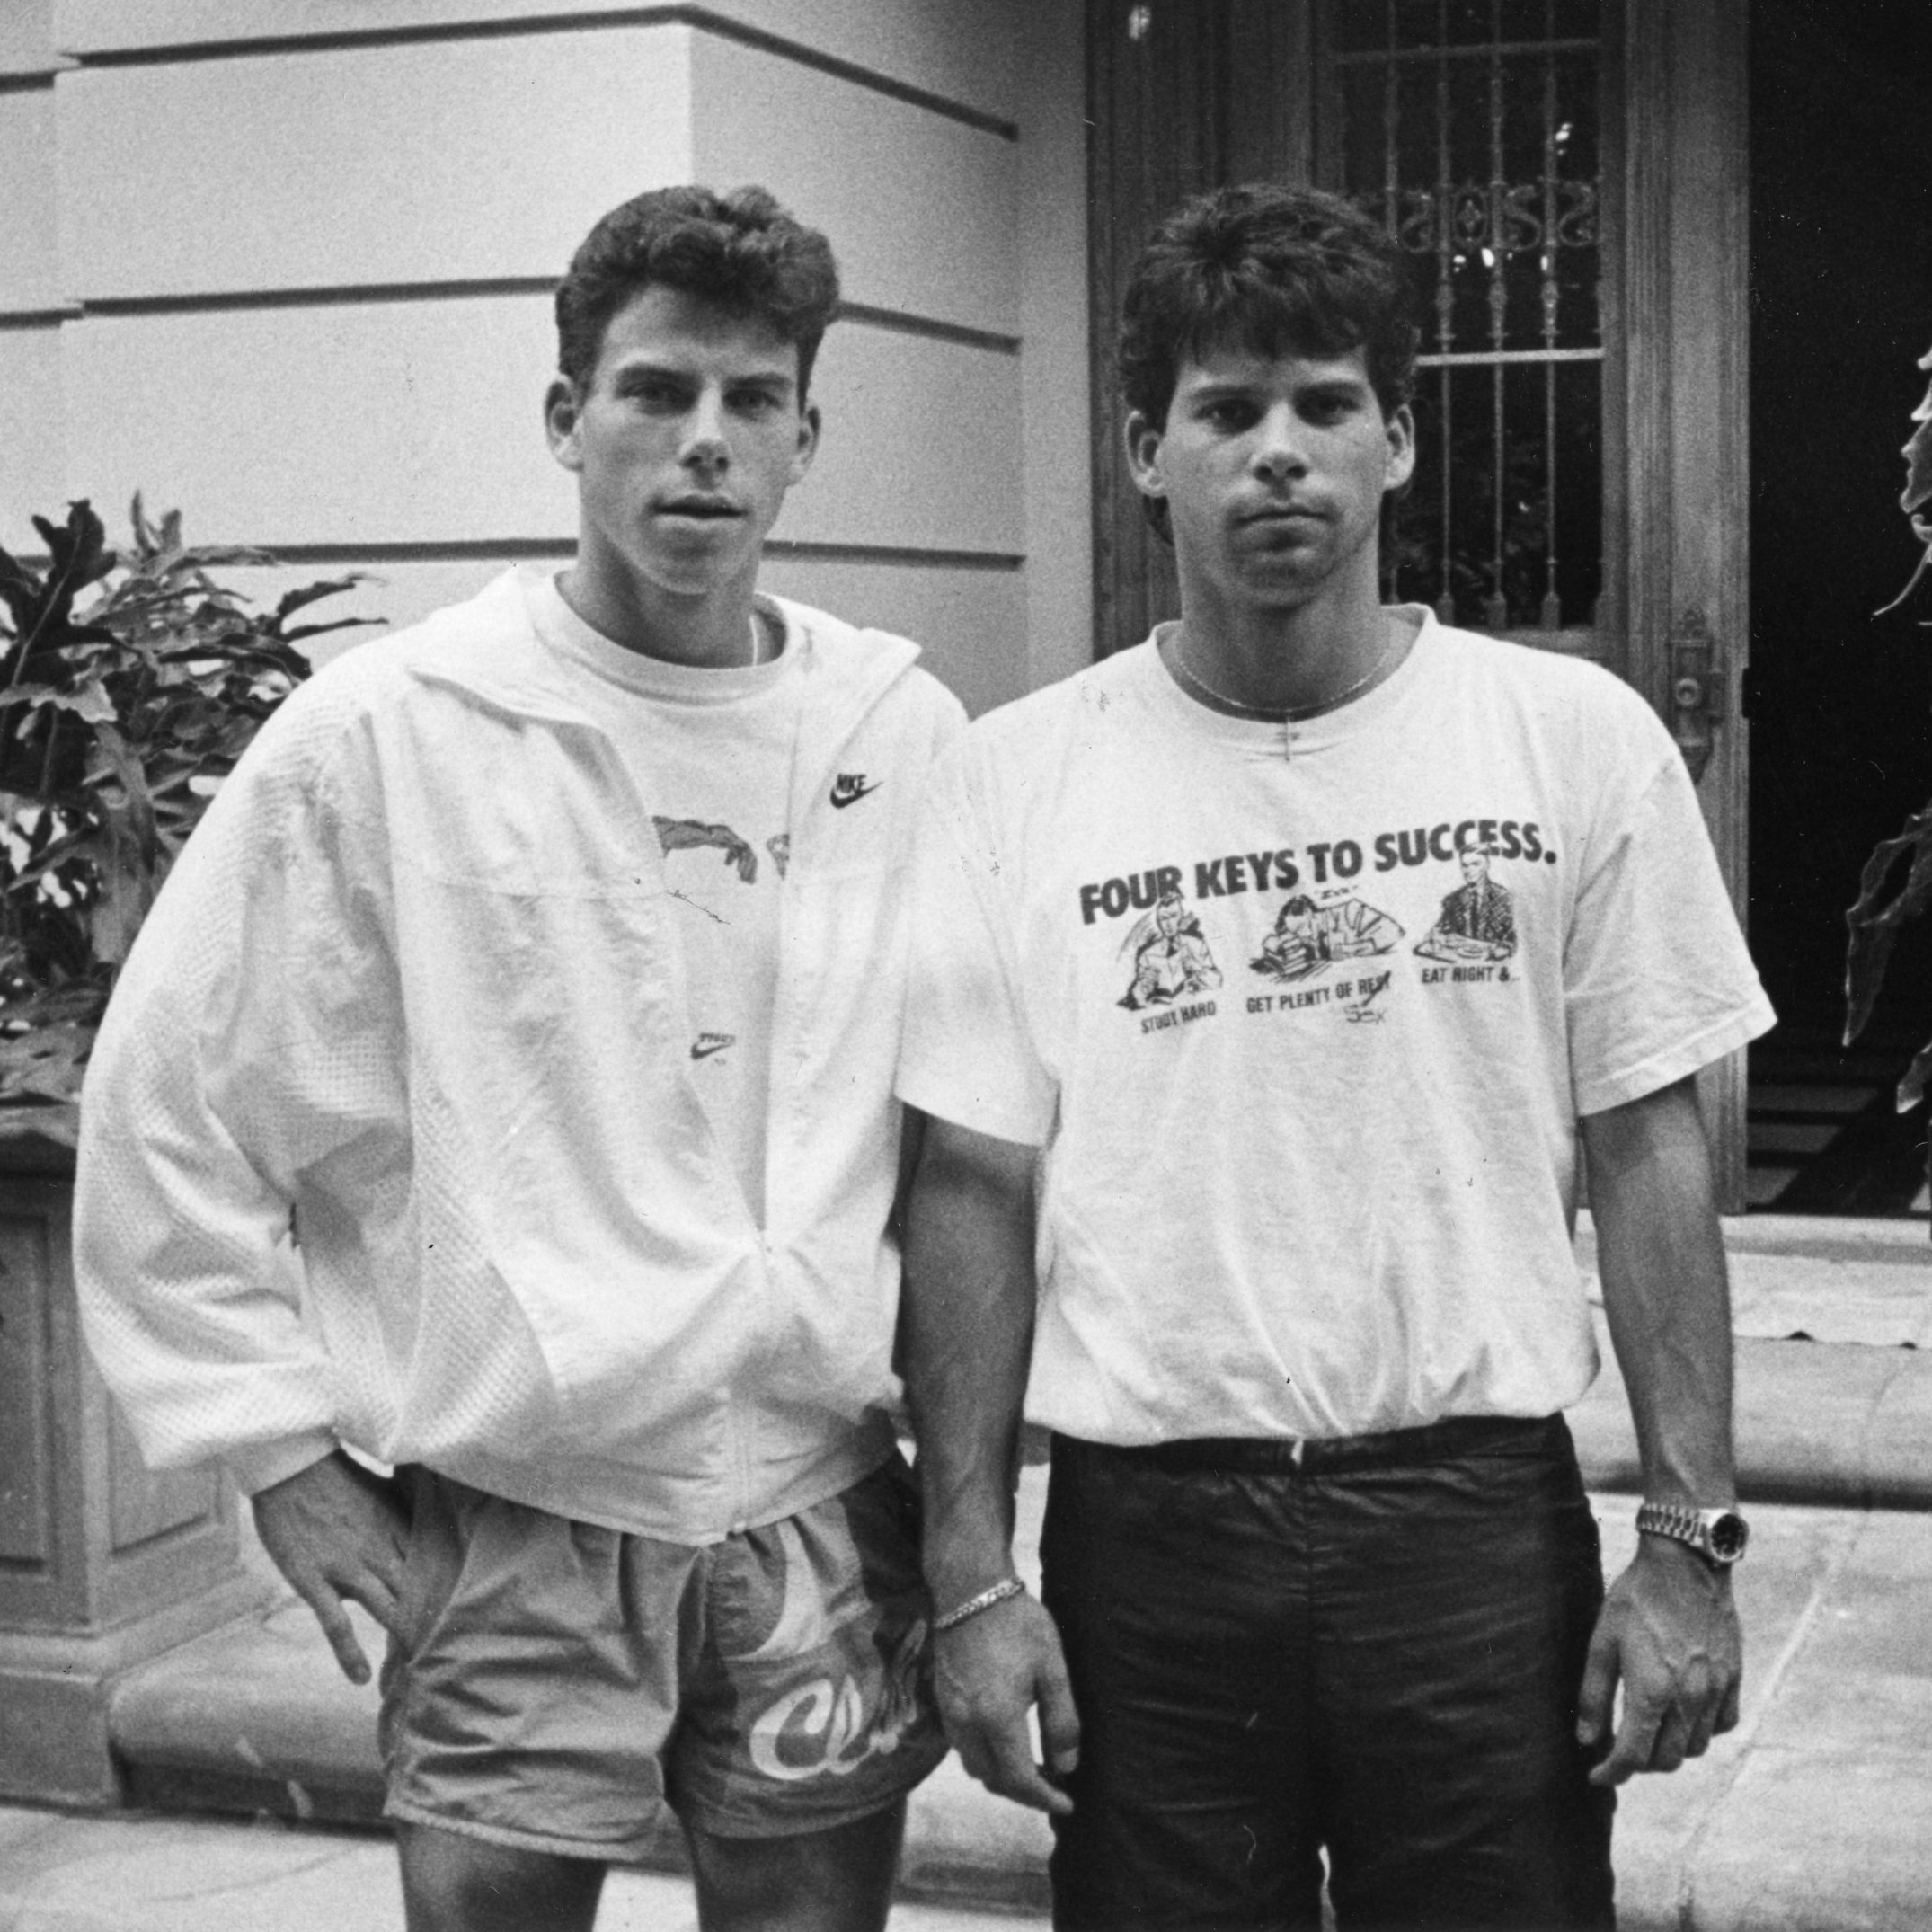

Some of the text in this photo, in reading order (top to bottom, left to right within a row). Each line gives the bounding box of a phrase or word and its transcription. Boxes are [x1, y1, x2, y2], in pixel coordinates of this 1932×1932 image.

[836, 773, 866, 793] NIKE
[1079, 819, 1557, 926] FOUR KEYS TO SUCCESS.
[1422, 965, 1511, 984] EAT RIGHT &
[1246, 996, 1272, 1014] GET
[1280, 986, 1330, 1011] PLENTY
[1335, 980, 1352, 999] OF
[1180, 999, 1217, 1023] HARD
